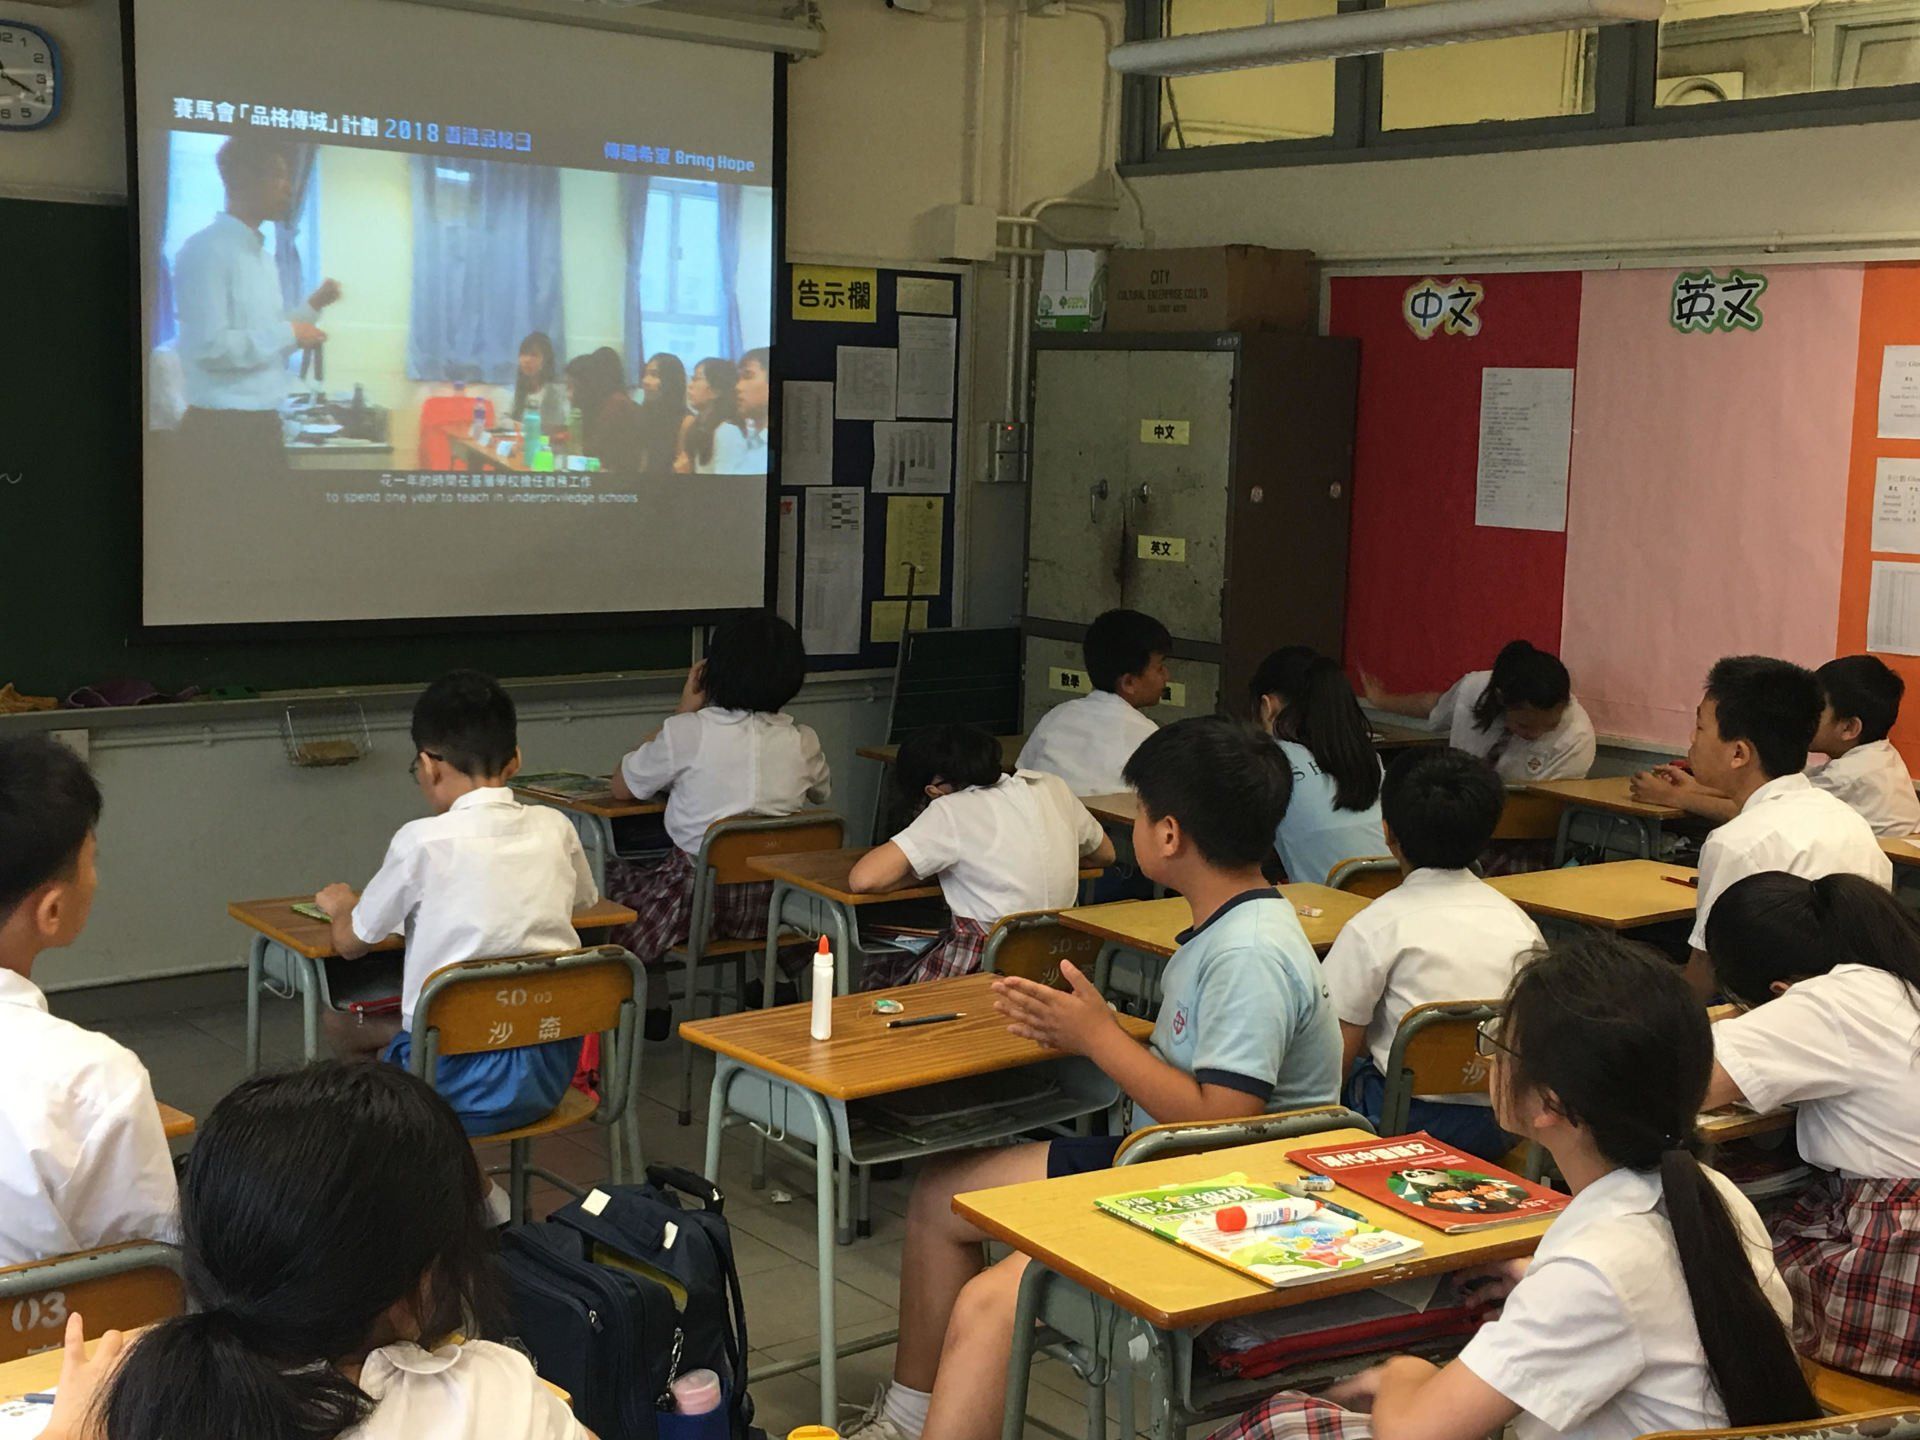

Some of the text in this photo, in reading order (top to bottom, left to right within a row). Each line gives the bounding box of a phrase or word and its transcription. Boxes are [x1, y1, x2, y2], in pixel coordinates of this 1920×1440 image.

[0, 32, 13, 43] 2
[33, 53, 44, 64] 2
[36, 73, 47, 84] 3
[384, 118, 440, 143] 2018
[675, 150, 715, 170] Bring
[718, 153, 756, 172] Hope
[797, 278, 871, 310] 告示欄
[1675, 277, 1760, 325] 英文
[1410, 286, 1477, 328] 中文
[1154, 424, 1175, 440] 中文
[326, 492, 339, 503] to
[344, 492, 381, 505] spend
[385, 494, 407, 503] one
[411, 494, 437, 506] year
[441, 492, 453, 503] to
[457, 491, 489, 503] teach
[598, 492, 638, 503] schools
[1151, 541, 1172, 557] 英文
[1317, 1142, 1434, 1168] 現代中國語文
[12, 1291, 67, 1332] 03
